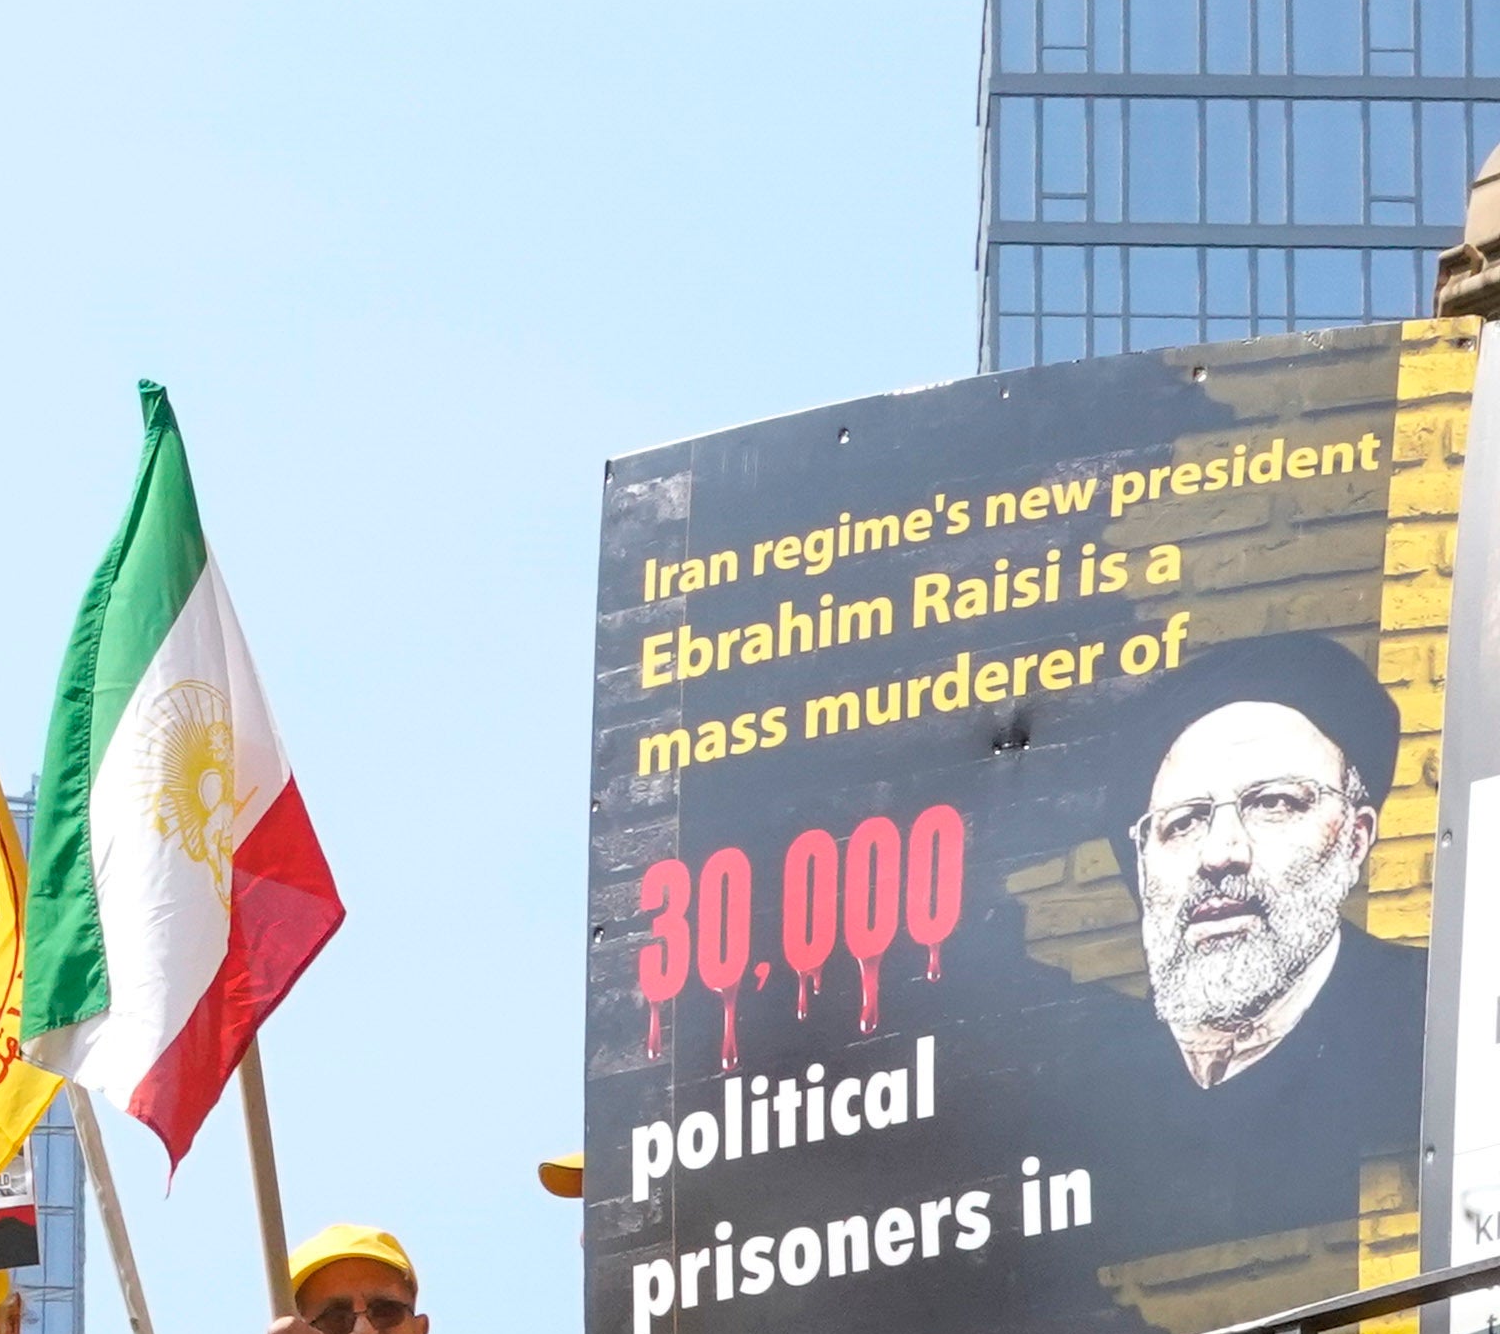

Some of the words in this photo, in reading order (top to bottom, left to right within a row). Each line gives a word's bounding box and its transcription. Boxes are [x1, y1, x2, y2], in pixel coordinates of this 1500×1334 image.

[643, 547, 738, 602] Iran
[752, 493, 971, 580] regime's
[984, 482, 1096, 531] new
[1111, 431, 1382, 516] president
[637, 697, 788, 777] mass
[804, 638, 1105, 741] murderer
[1120, 610, 1190, 673] of
[641, 591, 893, 689] Ebrahim
[913, 549, 1062, 627] Raisi
[1080, 543, 1128, 596] is
[1145, 541, 1183, 584] a
[639, 803, 966, 1012] 30,000
[632, 1035, 936, 1203] political
[1020, 1155, 1093, 1238] in
